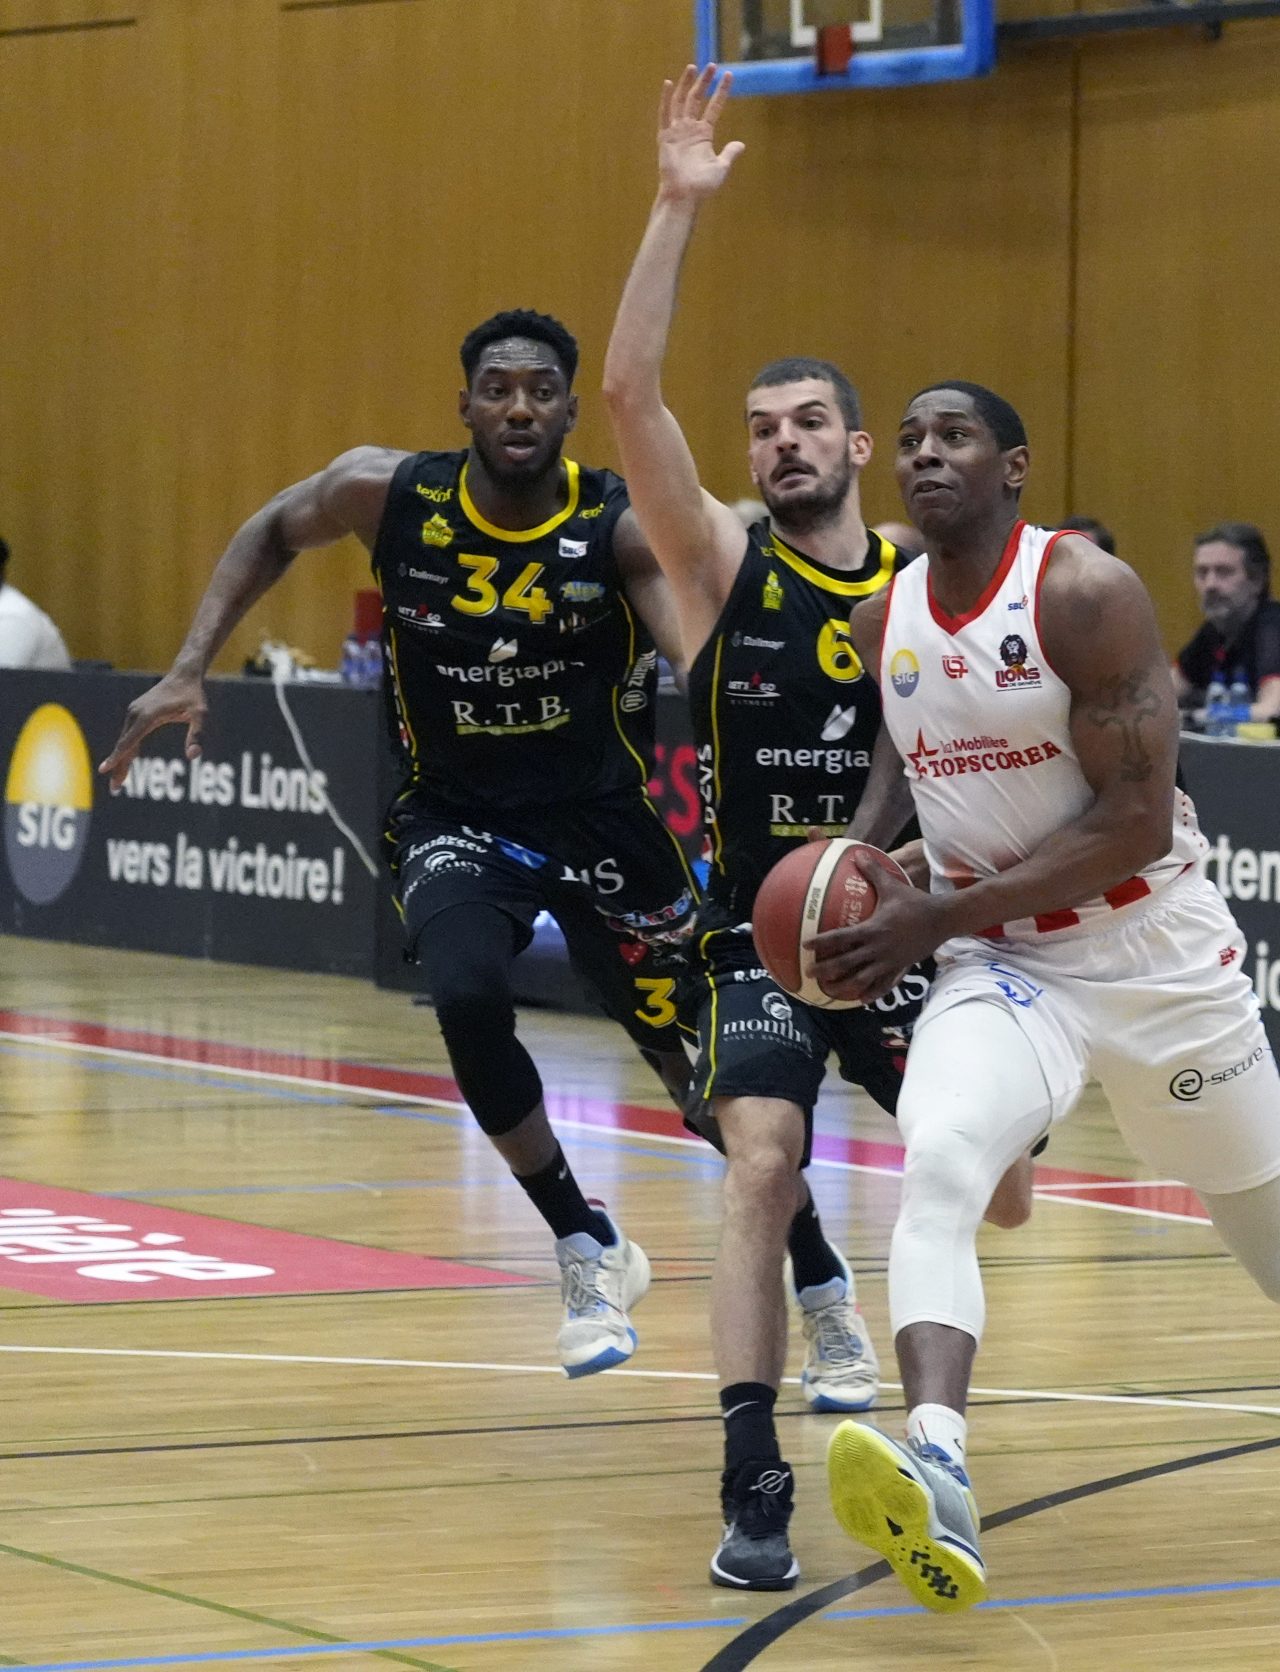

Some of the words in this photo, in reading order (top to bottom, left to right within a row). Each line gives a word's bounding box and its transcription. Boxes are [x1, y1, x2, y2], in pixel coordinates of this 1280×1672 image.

[451, 553, 553, 624] 34
[817, 618, 866, 683] 6
[895, 671, 915, 685] SIG
[996, 667, 1040, 687] LIONS
[190, 753, 235, 806] les
[241, 751, 328, 814] Lions
[17, 801, 76, 850] SIG
[107, 838, 171, 887] vers
[175, 832, 204, 890] la
